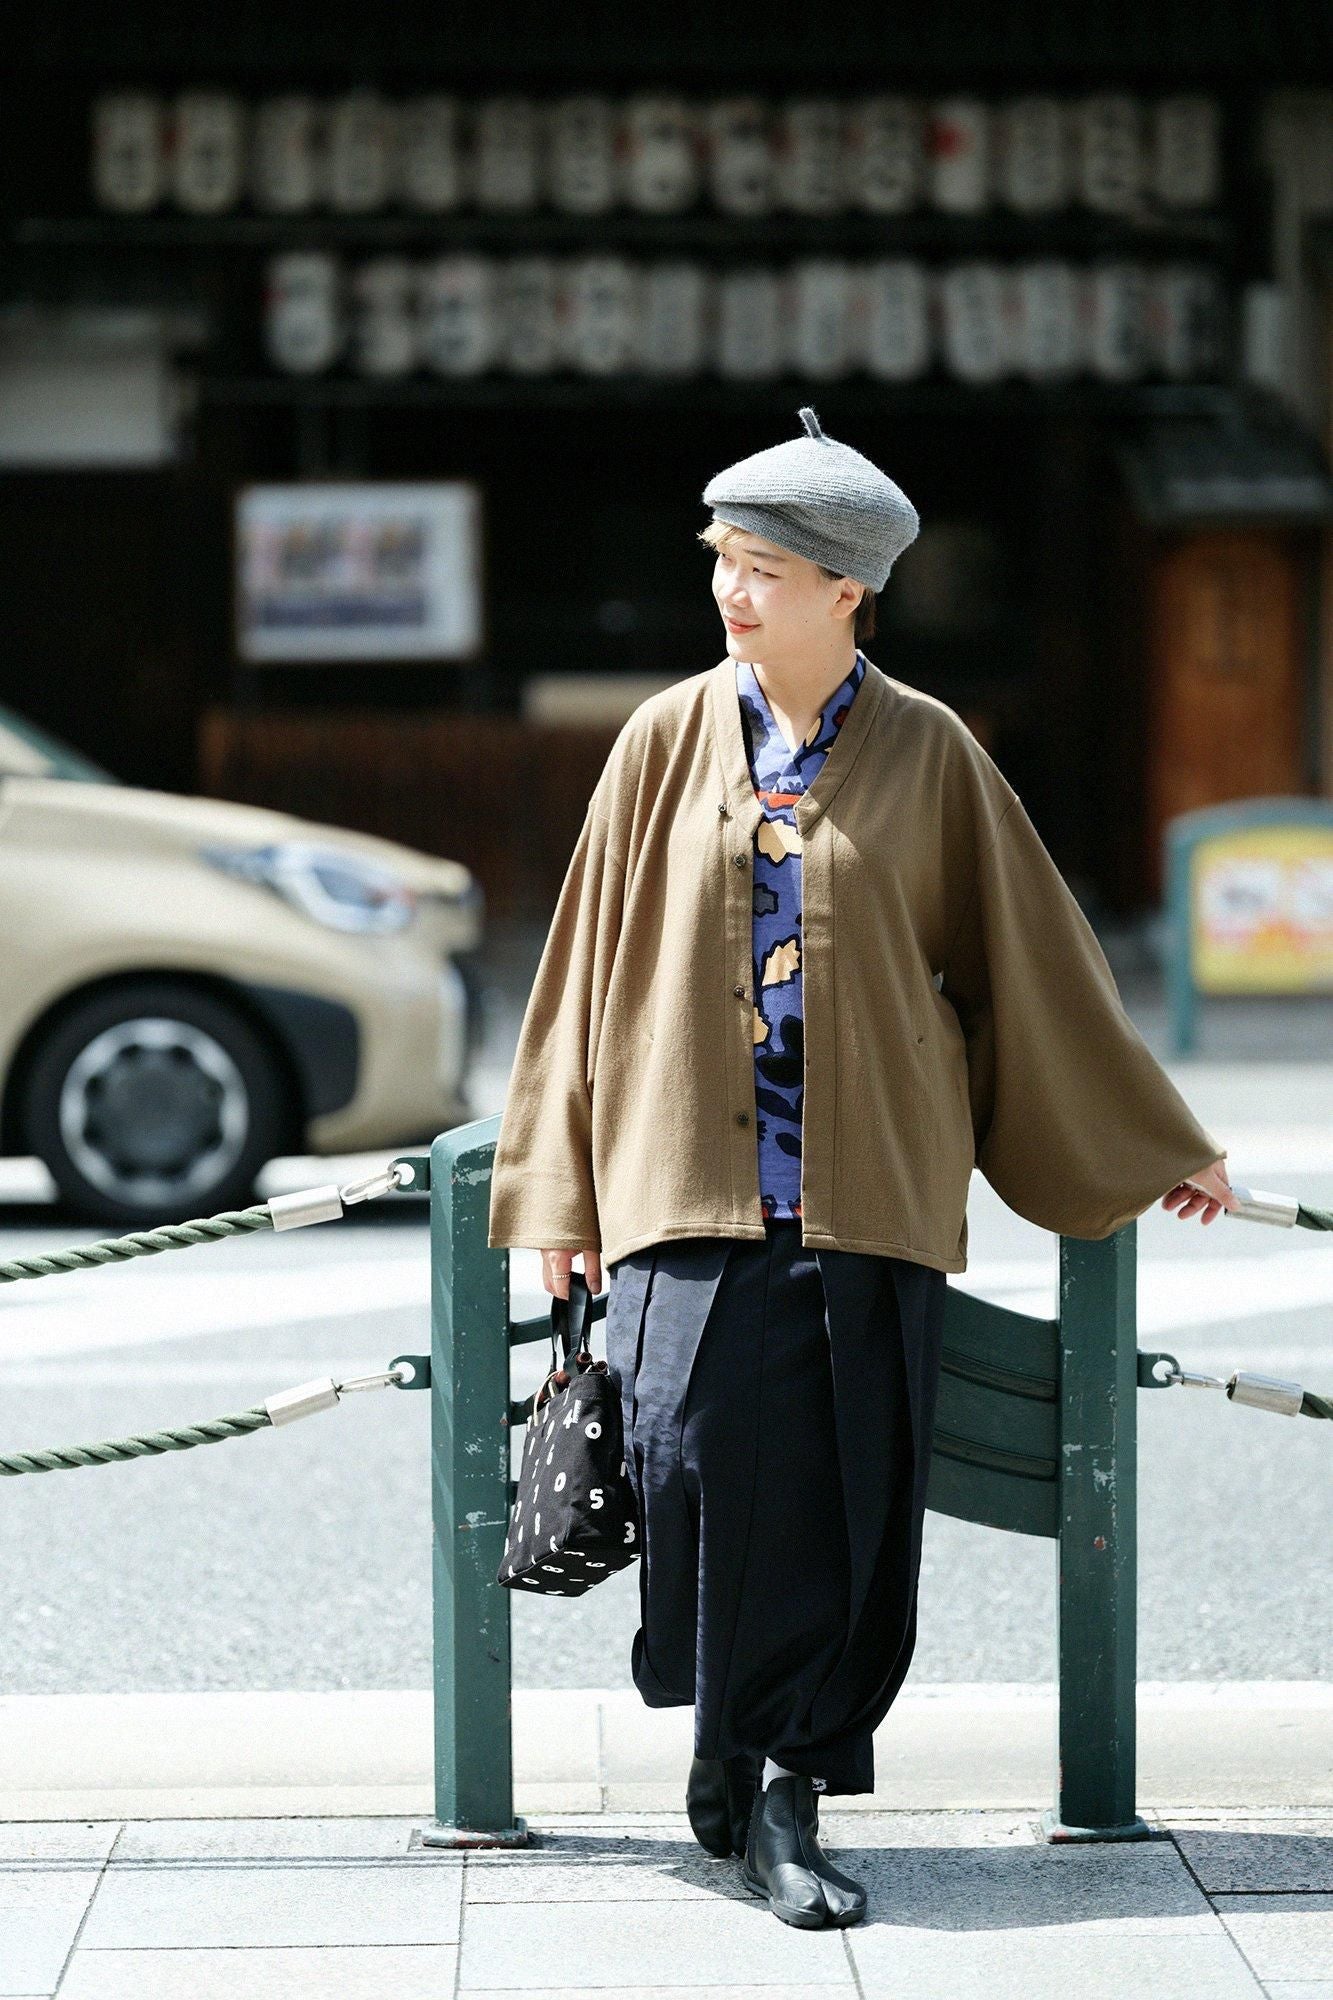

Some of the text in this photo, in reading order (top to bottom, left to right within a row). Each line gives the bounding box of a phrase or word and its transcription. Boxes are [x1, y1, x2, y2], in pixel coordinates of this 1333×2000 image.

[584, 1422, 601, 1439] 0
[554, 1472, 566, 1492] 0
[590, 1489, 604, 1509] 5
[624, 1522, 636, 1543] 3
[541, 1565, 565, 1573] 8
[521, 1577, 539, 1585] 0
